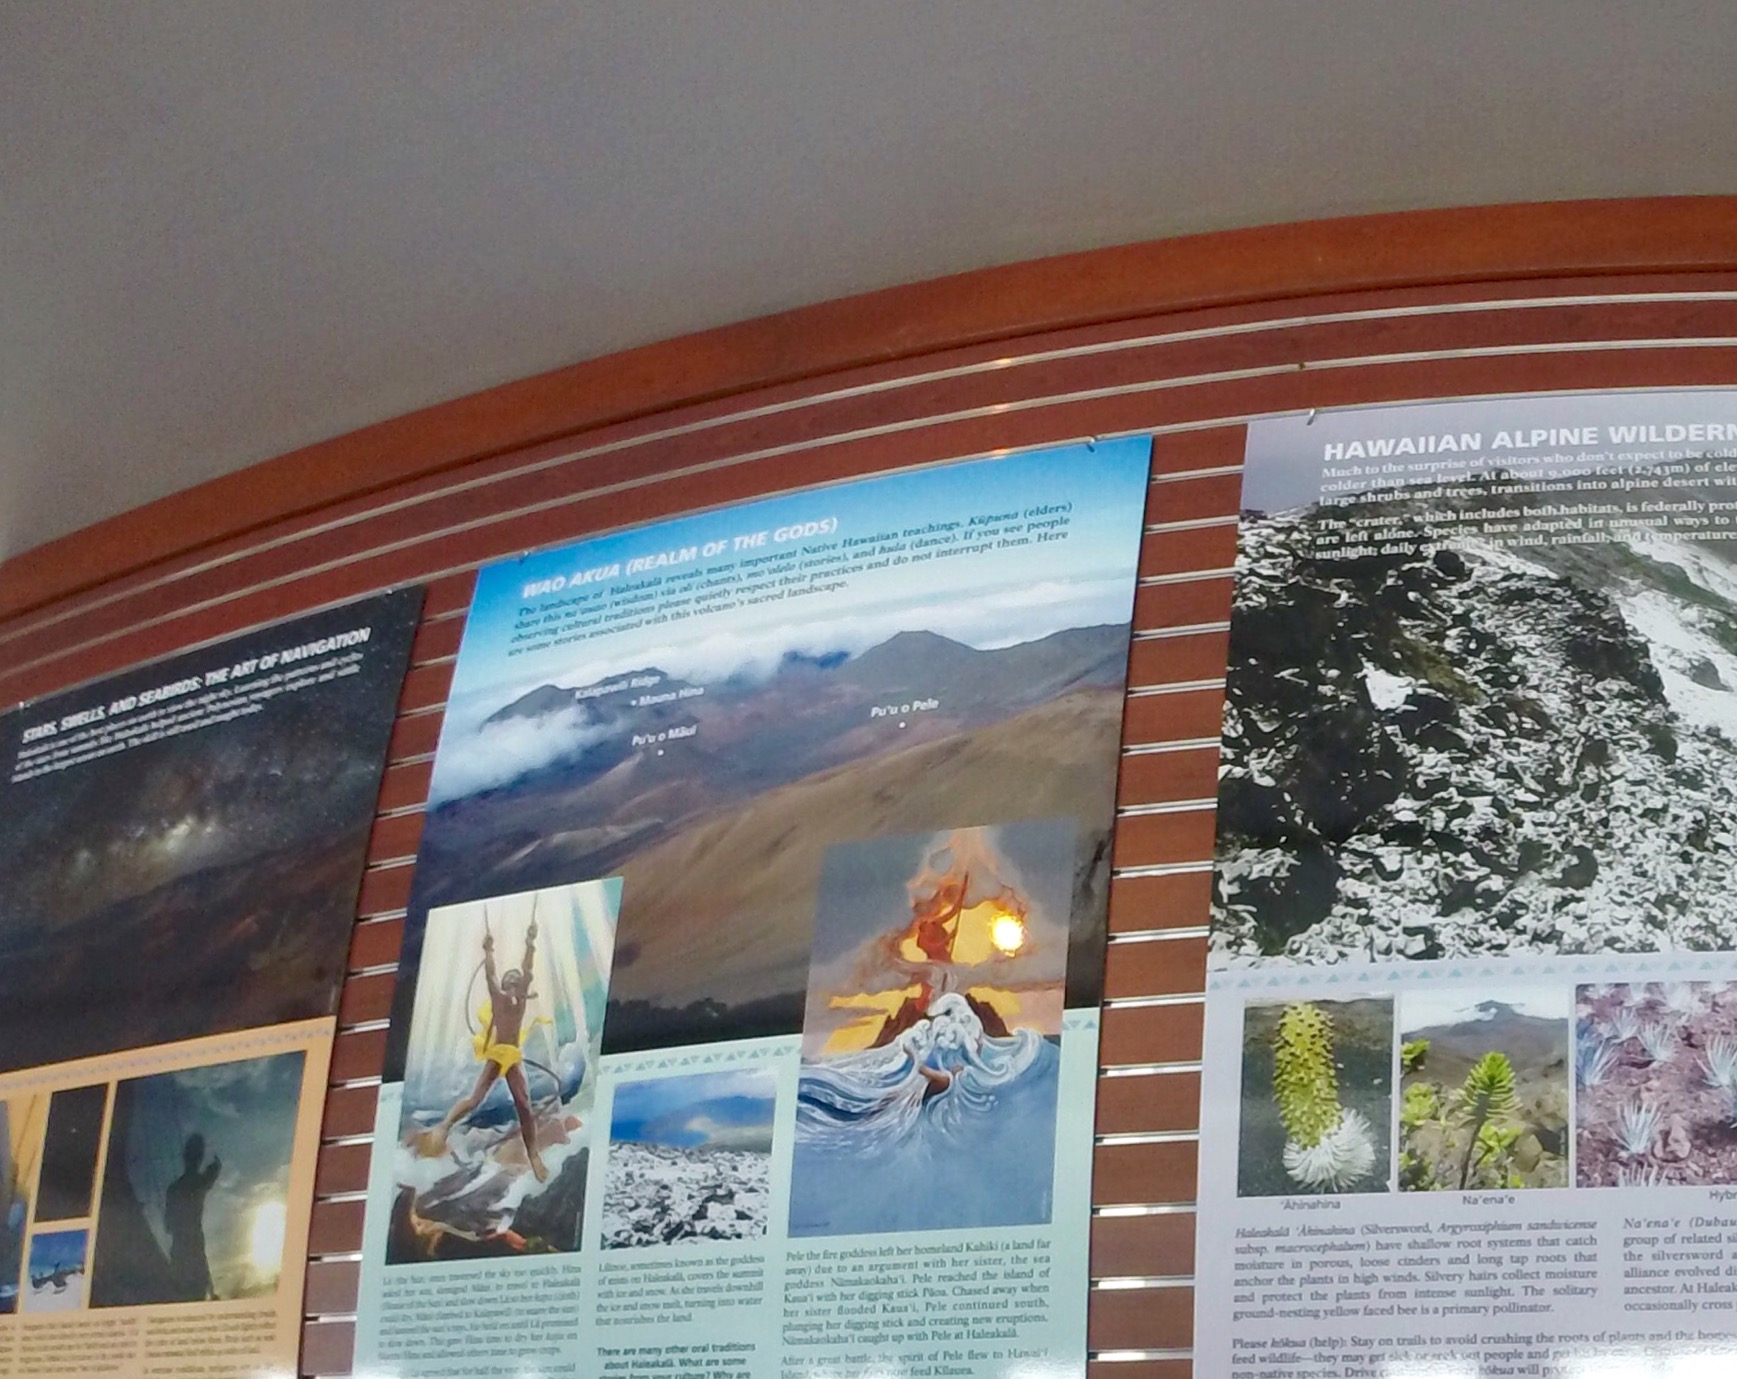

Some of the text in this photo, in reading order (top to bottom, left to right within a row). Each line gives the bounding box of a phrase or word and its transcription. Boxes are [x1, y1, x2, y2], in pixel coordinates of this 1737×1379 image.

[1324, 432, 1482, 461] HAWAIIAN
[1491, 426, 1599, 450] ALPINE
[1319, 491, 1356, 507] large
[1360, 487, 1410, 502] shrubs
[1412, 486, 1445, 500] and
[1446, 483, 1487, 498] trees,
[1491, 481, 1573, 495] transitions
[1576, 479, 1608, 491] into
[1610, 477, 1659, 492] alpine
[1662, 476, 1710, 488] desert
[1317, 516, 1346, 530] The
[1412, 509, 1457, 523] which
[1459, 506, 1521, 521] includes
[1523, 504, 1559, 517] both
[1559, 501, 1623, 517] habitats,
[1626, 501, 1639, 513] is
[1641, 500, 1706, 514] federally
[565, 563, 621, 590] AKUA
[624, 546, 698, 577] (REALM
[701, 539, 729, 558] OF
[733, 530, 769, 553] THE
[773, 516, 838, 543] GODS)
[798, 552, 850, 571] (stories),
[852, 545, 877, 560] and
[909, 532, 959, 551] (dance).
[963, 528, 975, 541] If
[976, 528, 1001, 541] you
[1003, 524, 1024, 534] see
[1026, 515, 1071, 534] people
[866, 531, 1069, 571] and do not interrupt them. Here
[1623, 1236, 1660, 1249] group
[1663, 1232, 1678, 1245] of
[1681, 1232, 1723, 1245] related
[1233, 1267, 1598, 1289] anchor the plants in high winds. Silvery hairs collect moisture
